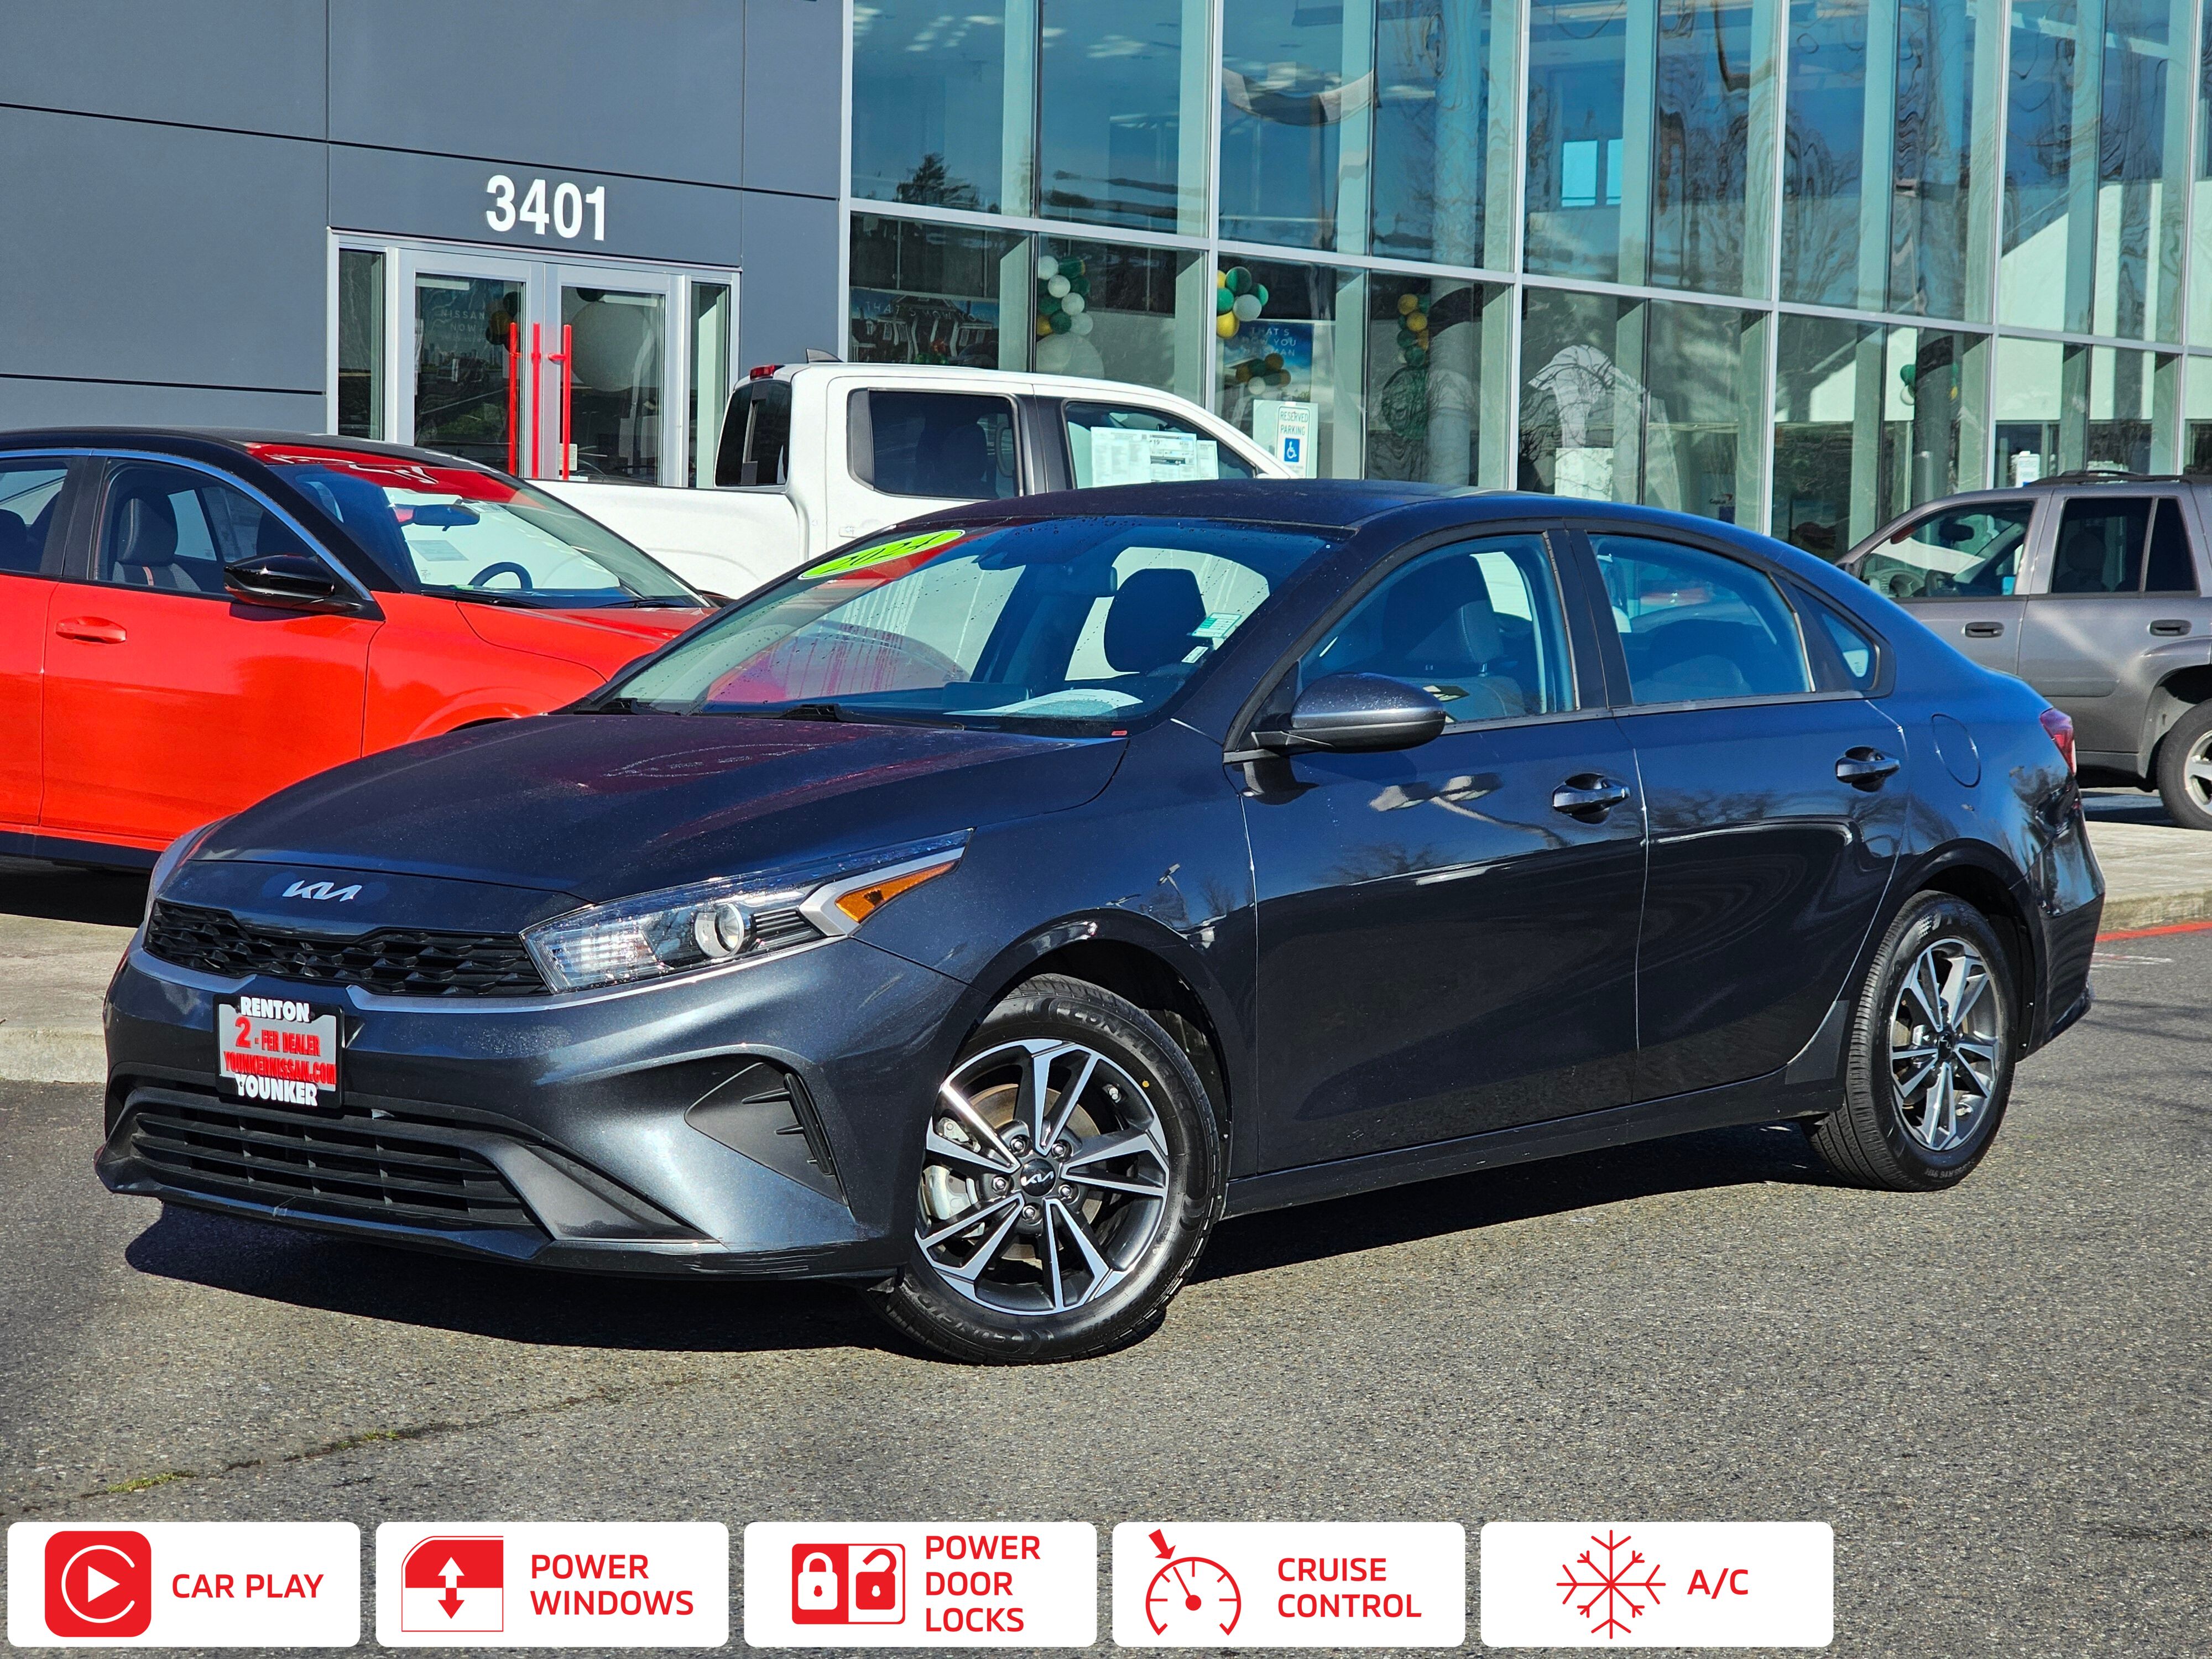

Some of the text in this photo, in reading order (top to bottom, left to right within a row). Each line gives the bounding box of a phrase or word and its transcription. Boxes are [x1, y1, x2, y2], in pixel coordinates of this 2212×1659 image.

[487, 175, 605, 241] 3401
[441, 310, 486, 320] NISSAN
[865, 300, 916, 316] THATS
[450, 323, 477, 332] NOW
[1251, 327, 1290, 336] THATS
[1280, 411, 1308, 422] RESERVED
[1280, 424, 1306, 436] PARKING
[282, 880, 362, 902] KIA
[240, 996, 310, 1022] RENTON
[282, 1032, 321, 1057] DEALER
[223, 1051, 336, 1084] YOUNKERNISSAN.COM
[234, 1073, 317, 1107] YOUNKER
[1020, 1171, 1054, 1186] KIA
